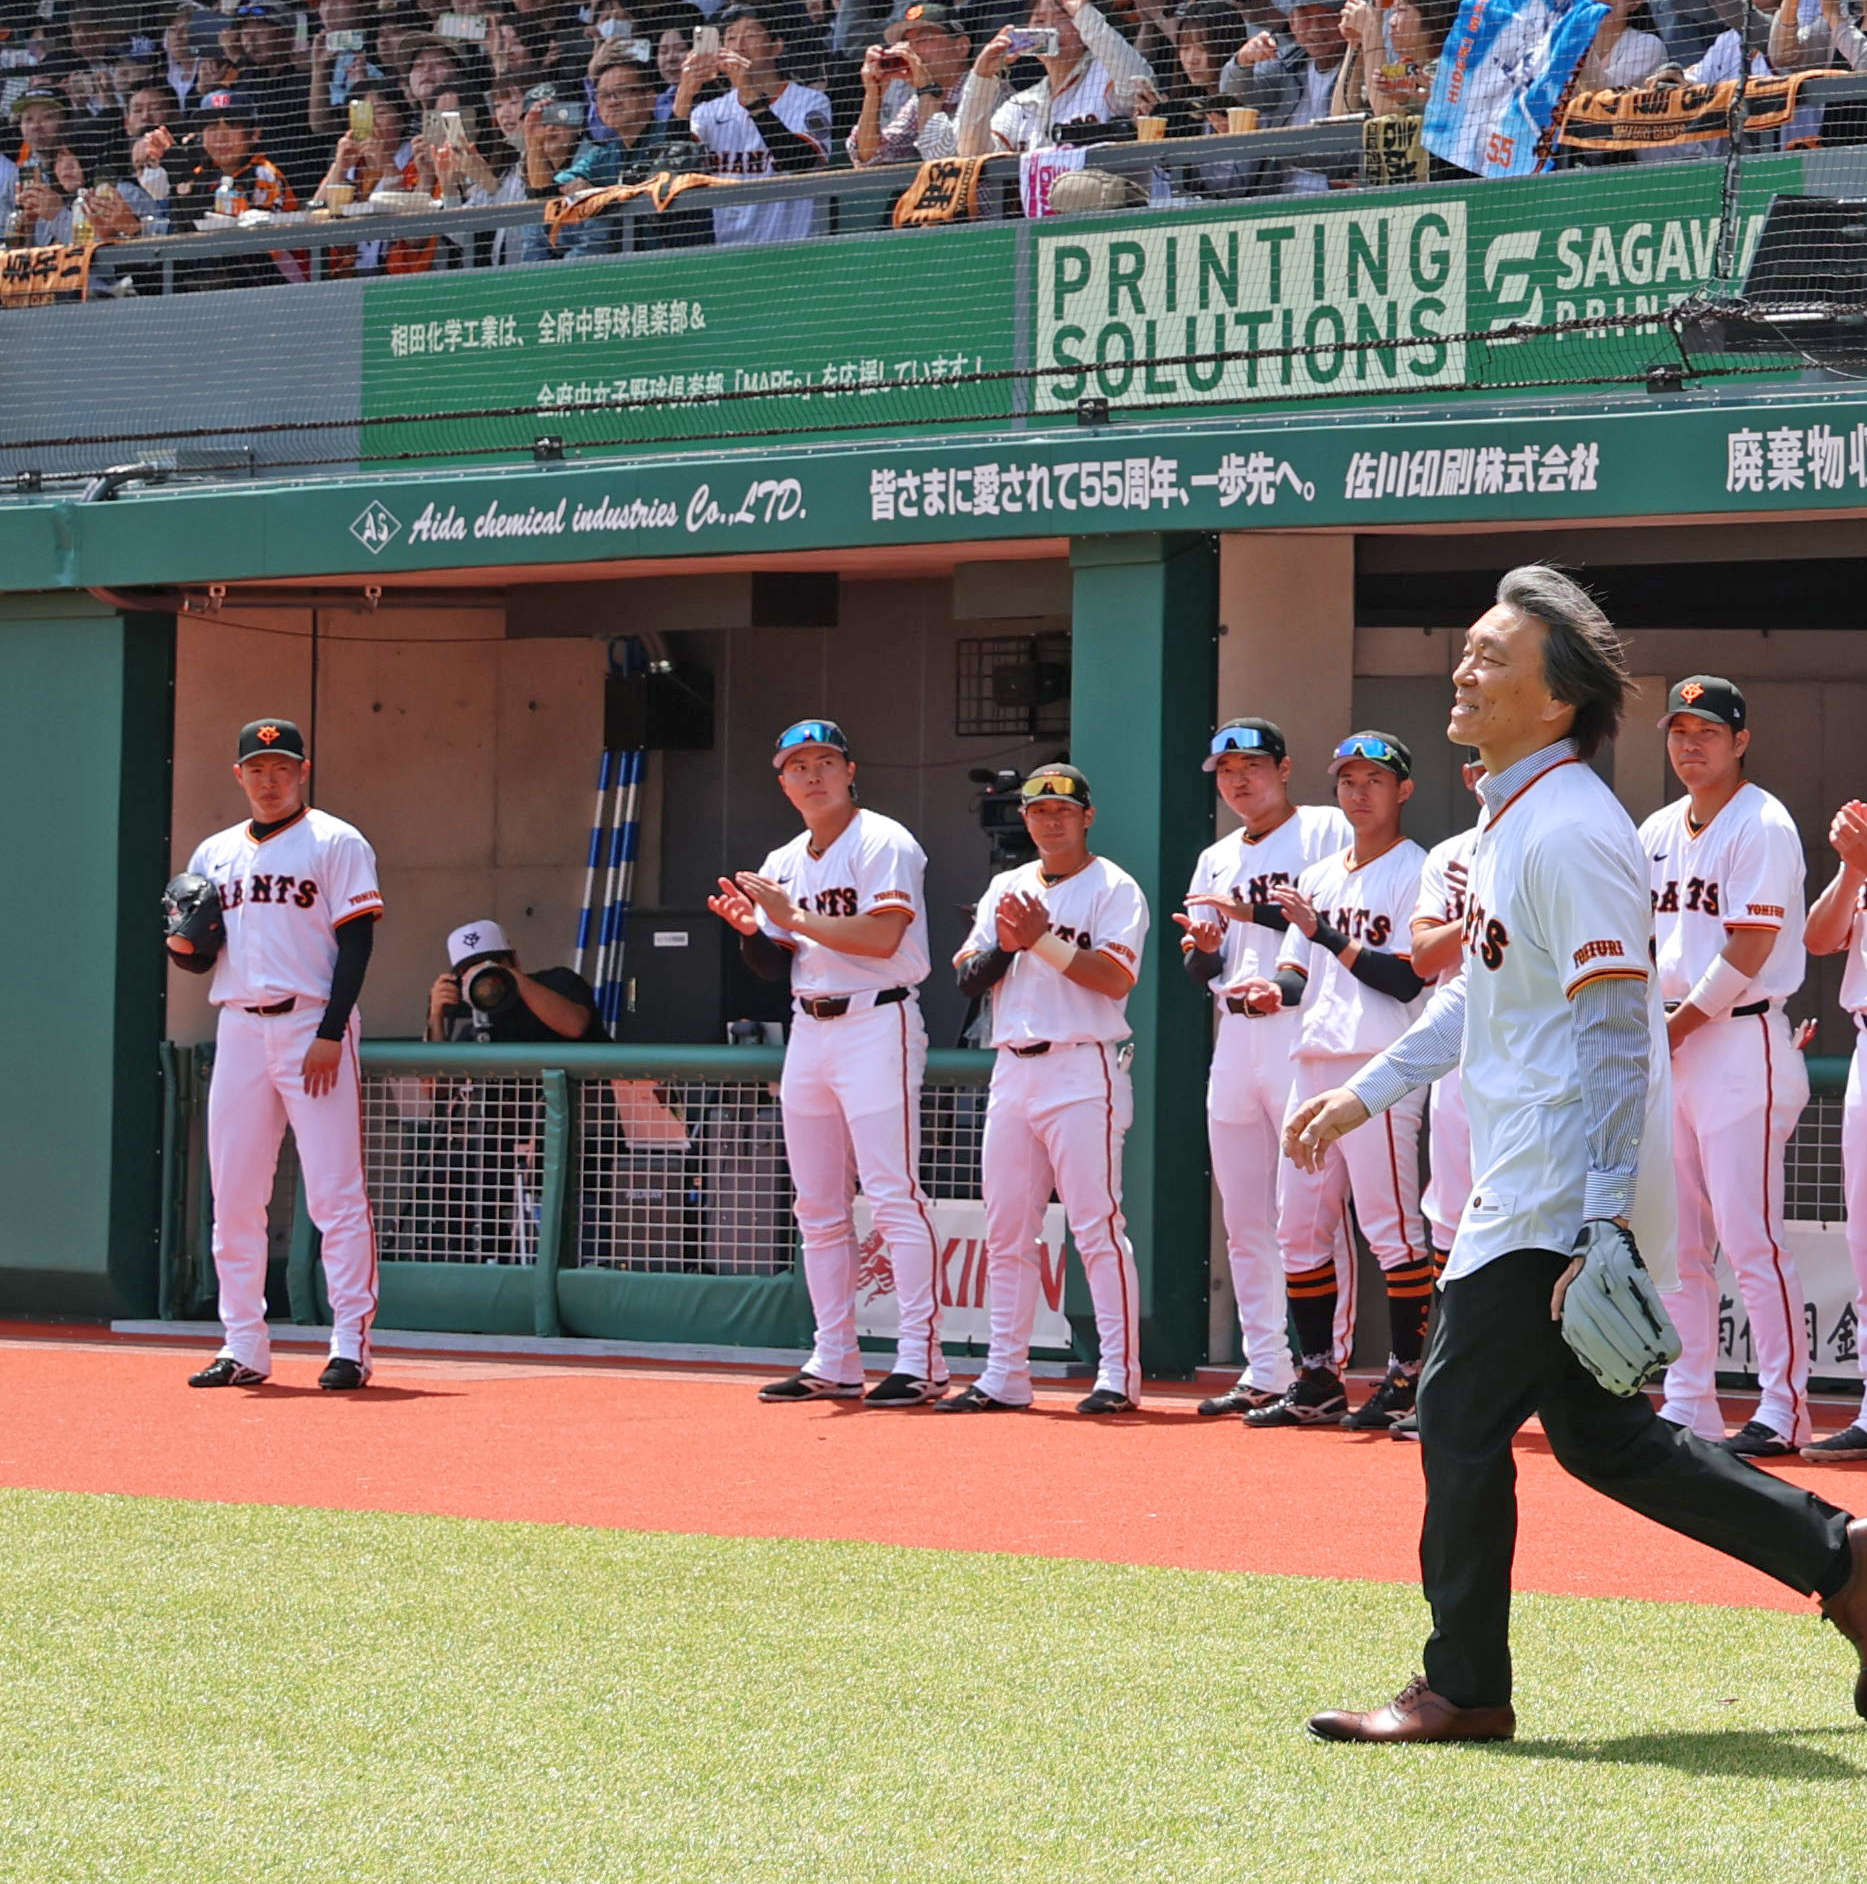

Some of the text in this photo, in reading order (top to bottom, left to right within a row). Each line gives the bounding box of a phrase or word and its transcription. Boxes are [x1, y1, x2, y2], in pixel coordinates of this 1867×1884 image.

[1486, 131, 1514, 170] 55
[1054, 212, 1450, 320] PRINTING
[1050, 297, 1448, 401] SOLUTIONS
[869, 451, 1315, 520] 皆さまに愛されて55周年、一歩先へ。
[1344, 443, 1599, 499] 佐川印刷株式会社
[408, 502, 467, 544] Aida
[474, 497, 567, 538] chemical
[571, 495, 678, 532] industries
[219, 874, 319, 912] IANTS
